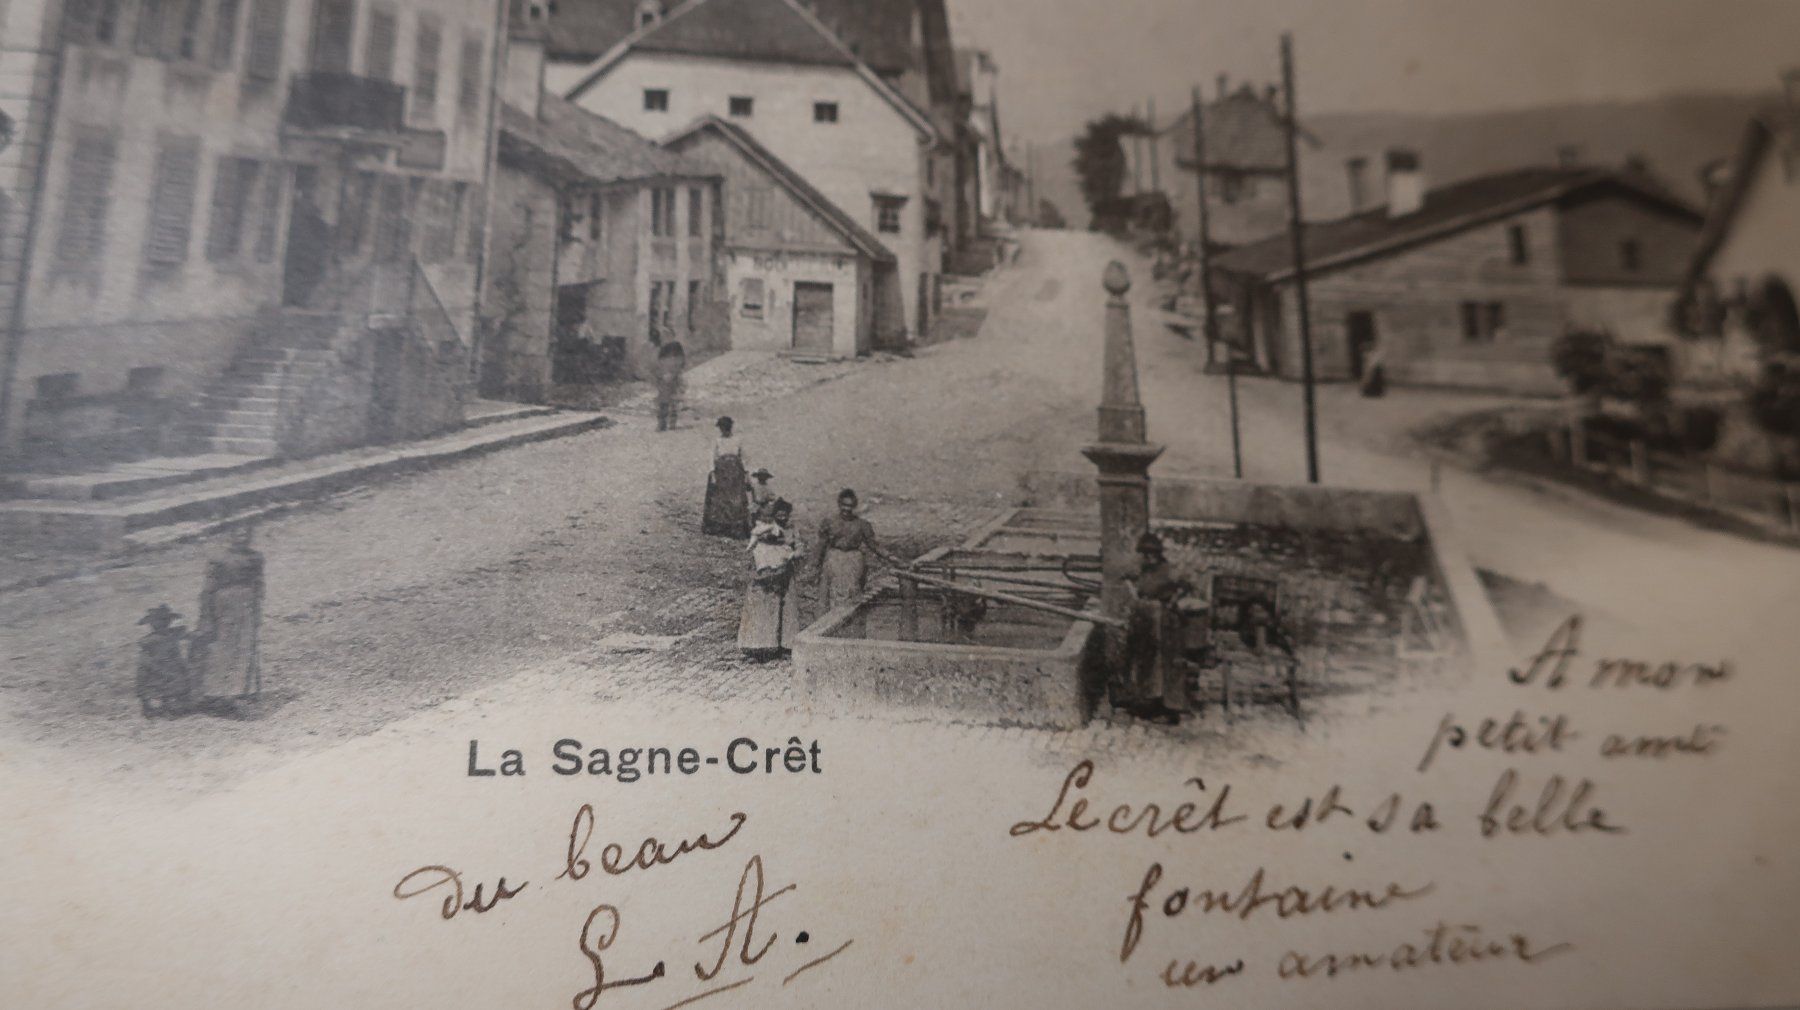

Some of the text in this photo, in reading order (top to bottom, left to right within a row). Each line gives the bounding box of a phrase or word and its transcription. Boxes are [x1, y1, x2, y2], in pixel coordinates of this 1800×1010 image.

[1508, 613, 1736, 690] A mon
[468, 737, 822, 783] La Sagne-Crêt
[1416, 710, 1582, 773] petit
[1265, 784, 1354, 831] est
[1481, 767, 1630, 840] belle
[555, 803, 748, 881] beau
[1120, 850, 1438, 961] fontaine
